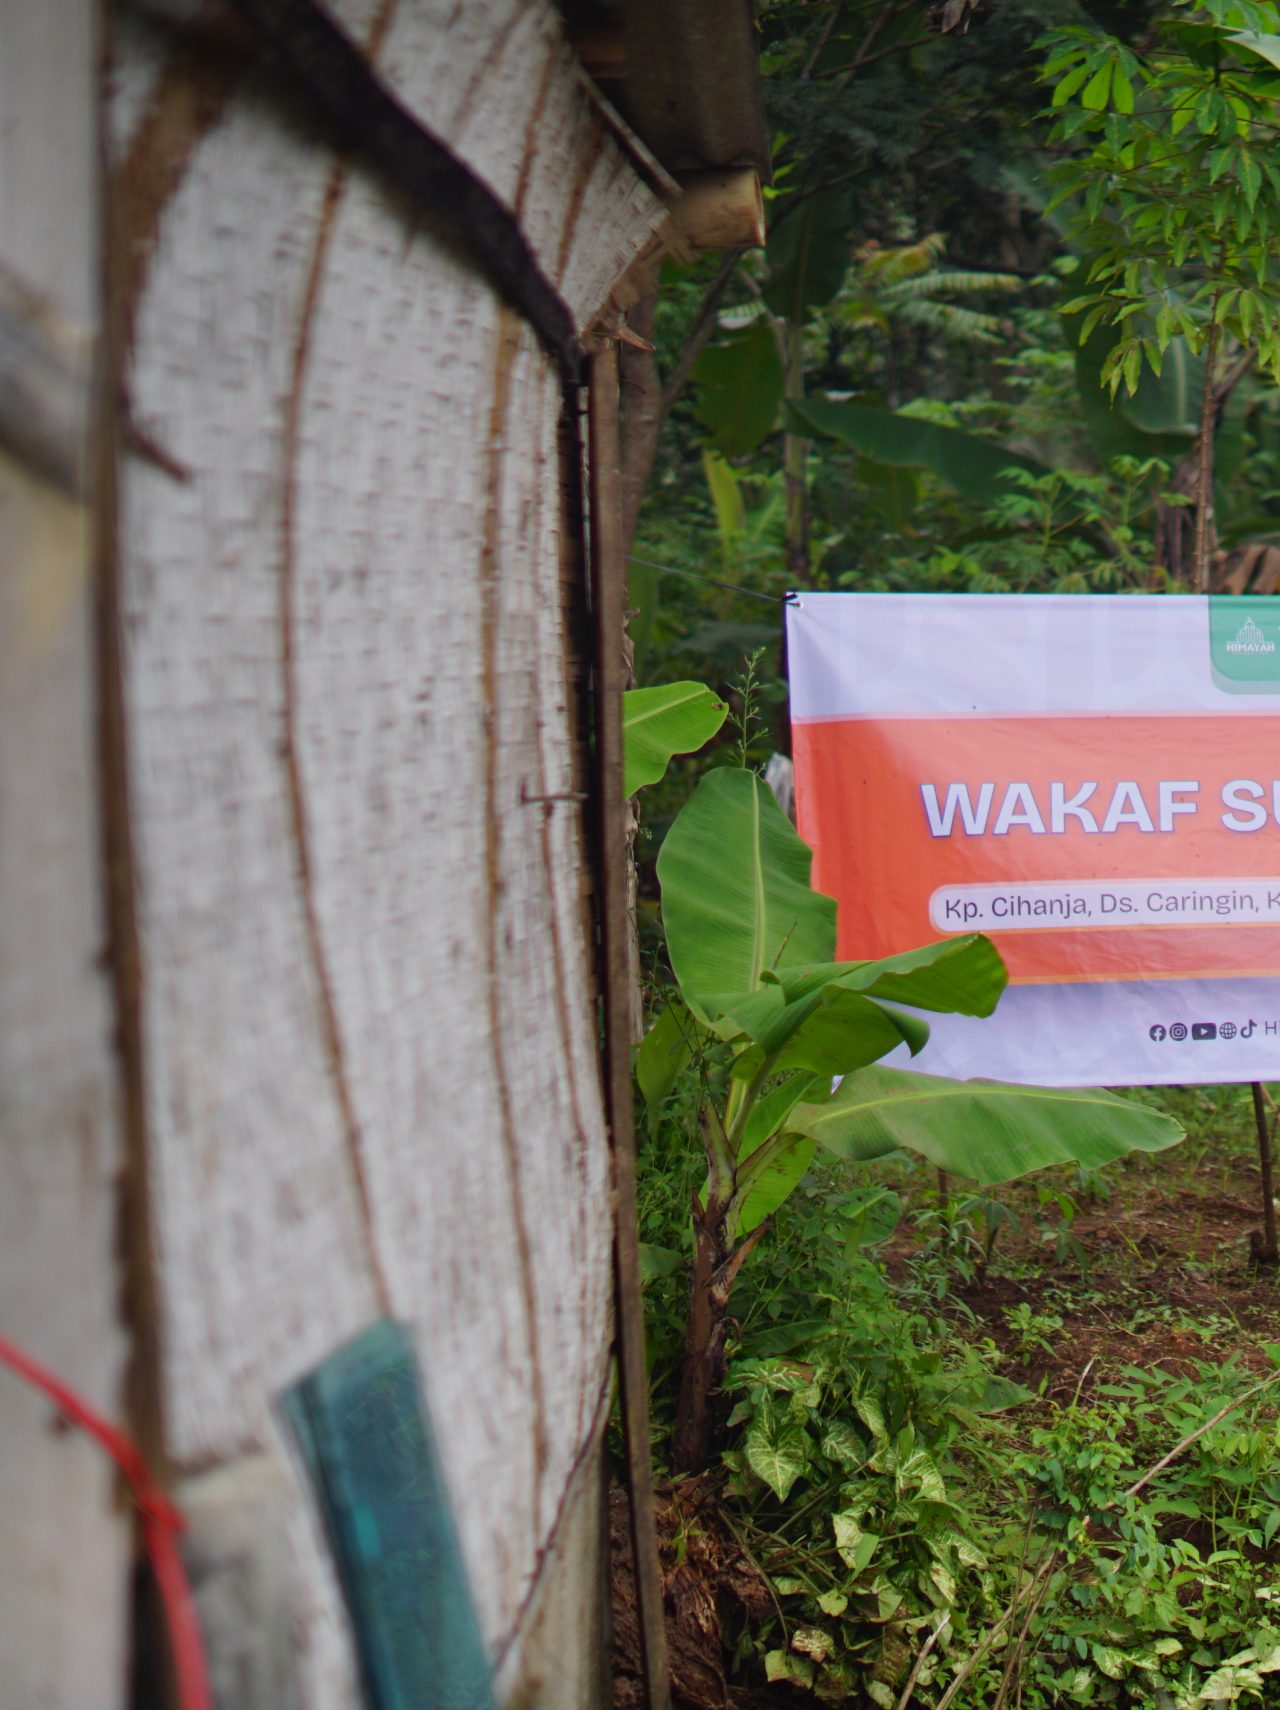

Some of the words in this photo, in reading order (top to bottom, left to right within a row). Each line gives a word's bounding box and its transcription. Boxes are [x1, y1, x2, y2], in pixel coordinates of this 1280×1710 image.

[1226, 641, 1276, 652] HIMAYAH
[920, 780, 1200, 837] WAKAF
[945, 898, 983, 920] Kp.
[991, 893, 1092, 918] Cihanja,
[1100, 893, 1138, 914] Ds.
[1146, 890, 1259, 914] Caringin,
